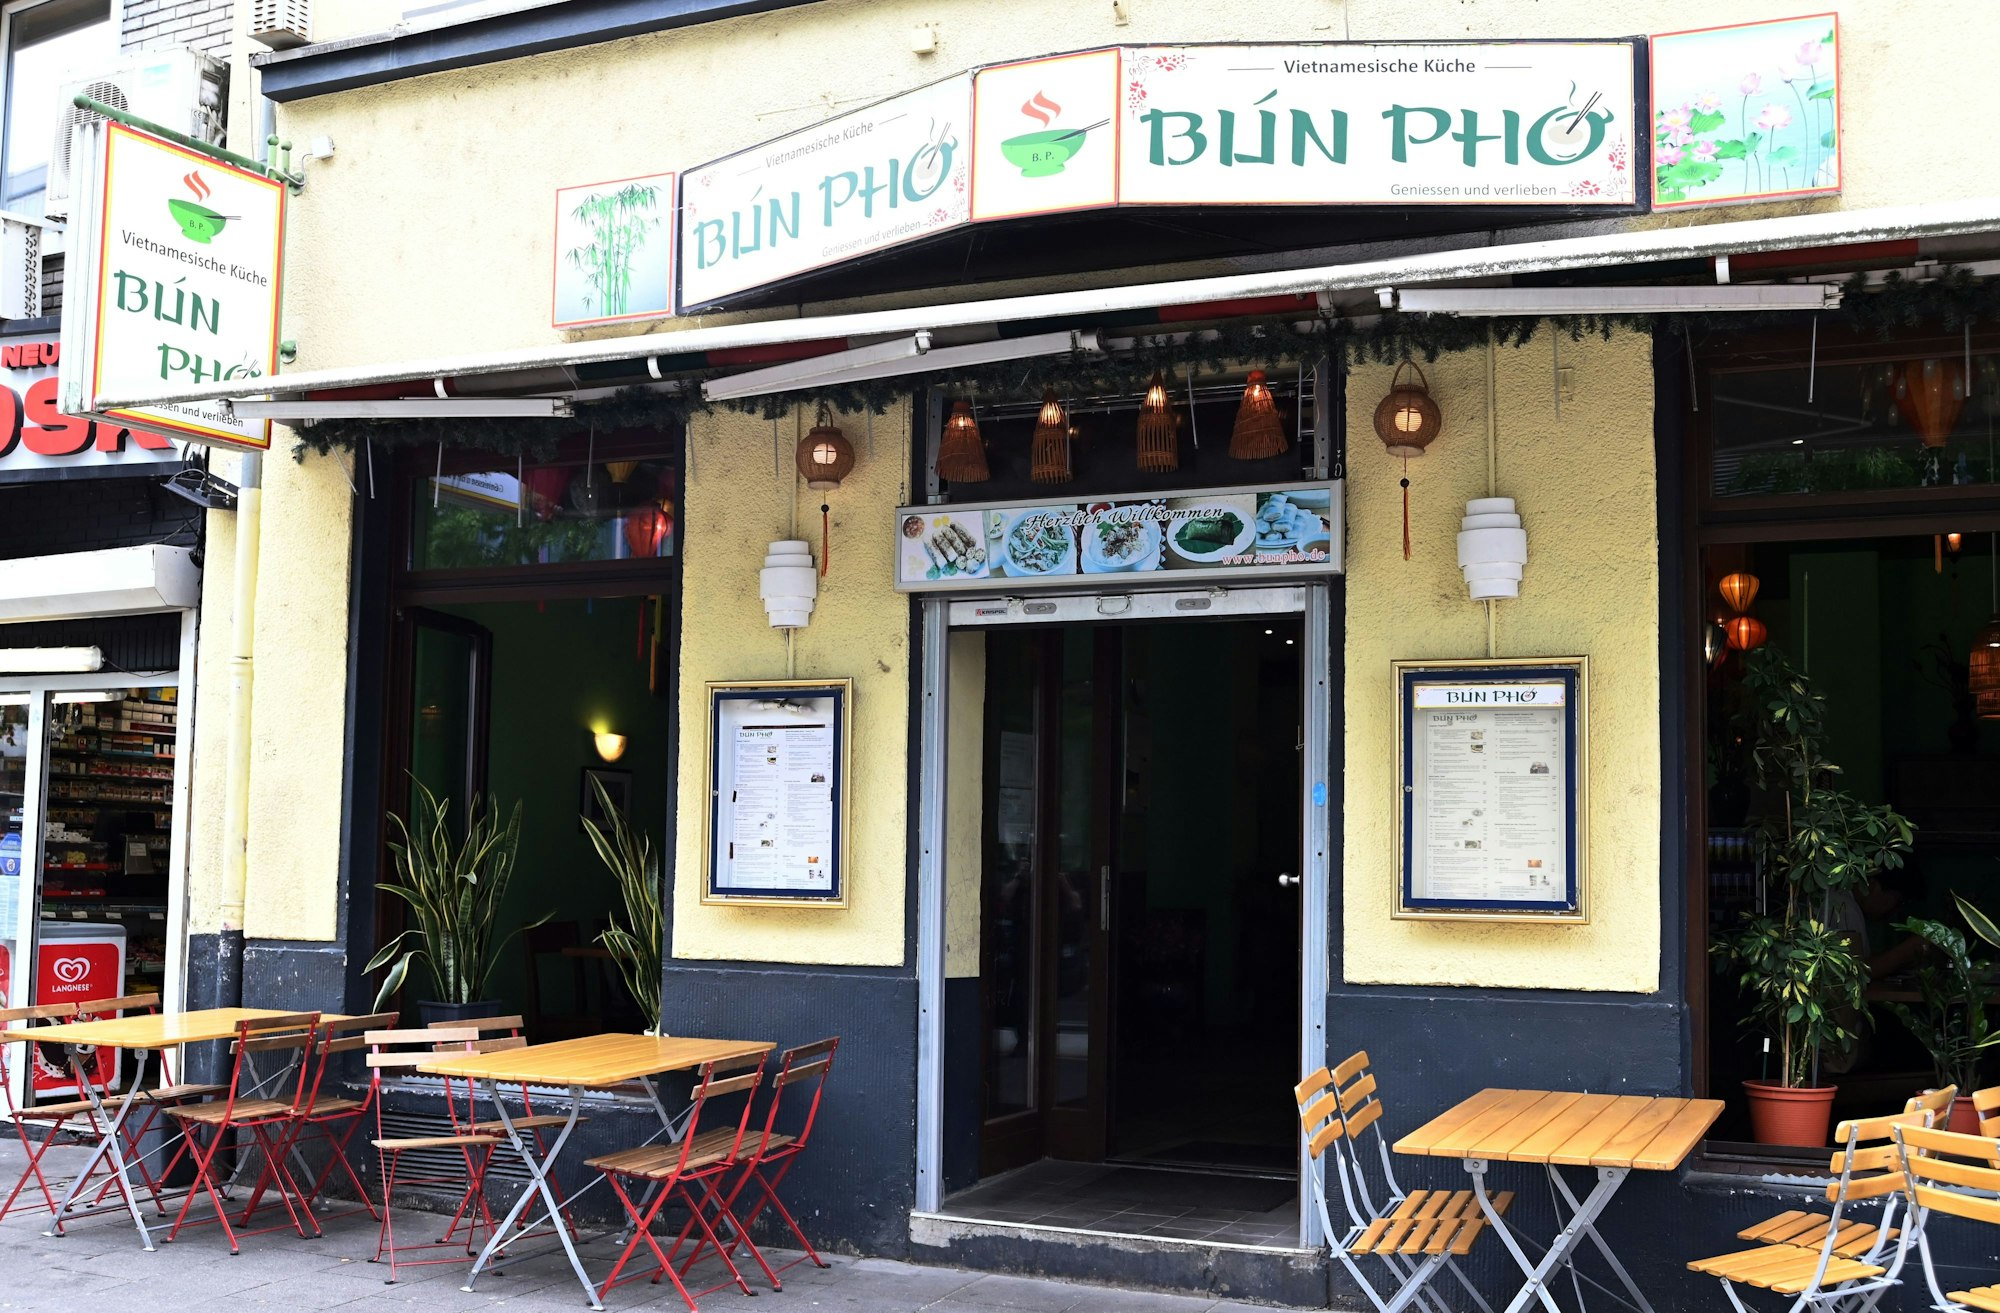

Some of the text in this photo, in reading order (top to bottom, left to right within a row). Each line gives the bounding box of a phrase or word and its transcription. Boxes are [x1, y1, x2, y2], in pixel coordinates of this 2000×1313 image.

[1284, 57, 1476, 74] Vietnamesische Küche
[766, 120, 873, 169] Vietnamesische Küche
[1390, 184, 1556, 196] Geniessen und verlieben
[821, 220, 921, 257] Geniessen und verlieben
[122, 229, 268, 287] Vietnamesische Küche
[182, 406, 200, 418] und
[1026, 505, 1225, 531] Herzlich Willkommen
[1222, 549, 1326, 566] www.bunpho.de
[51, 983, 90, 993] LANGNESE
